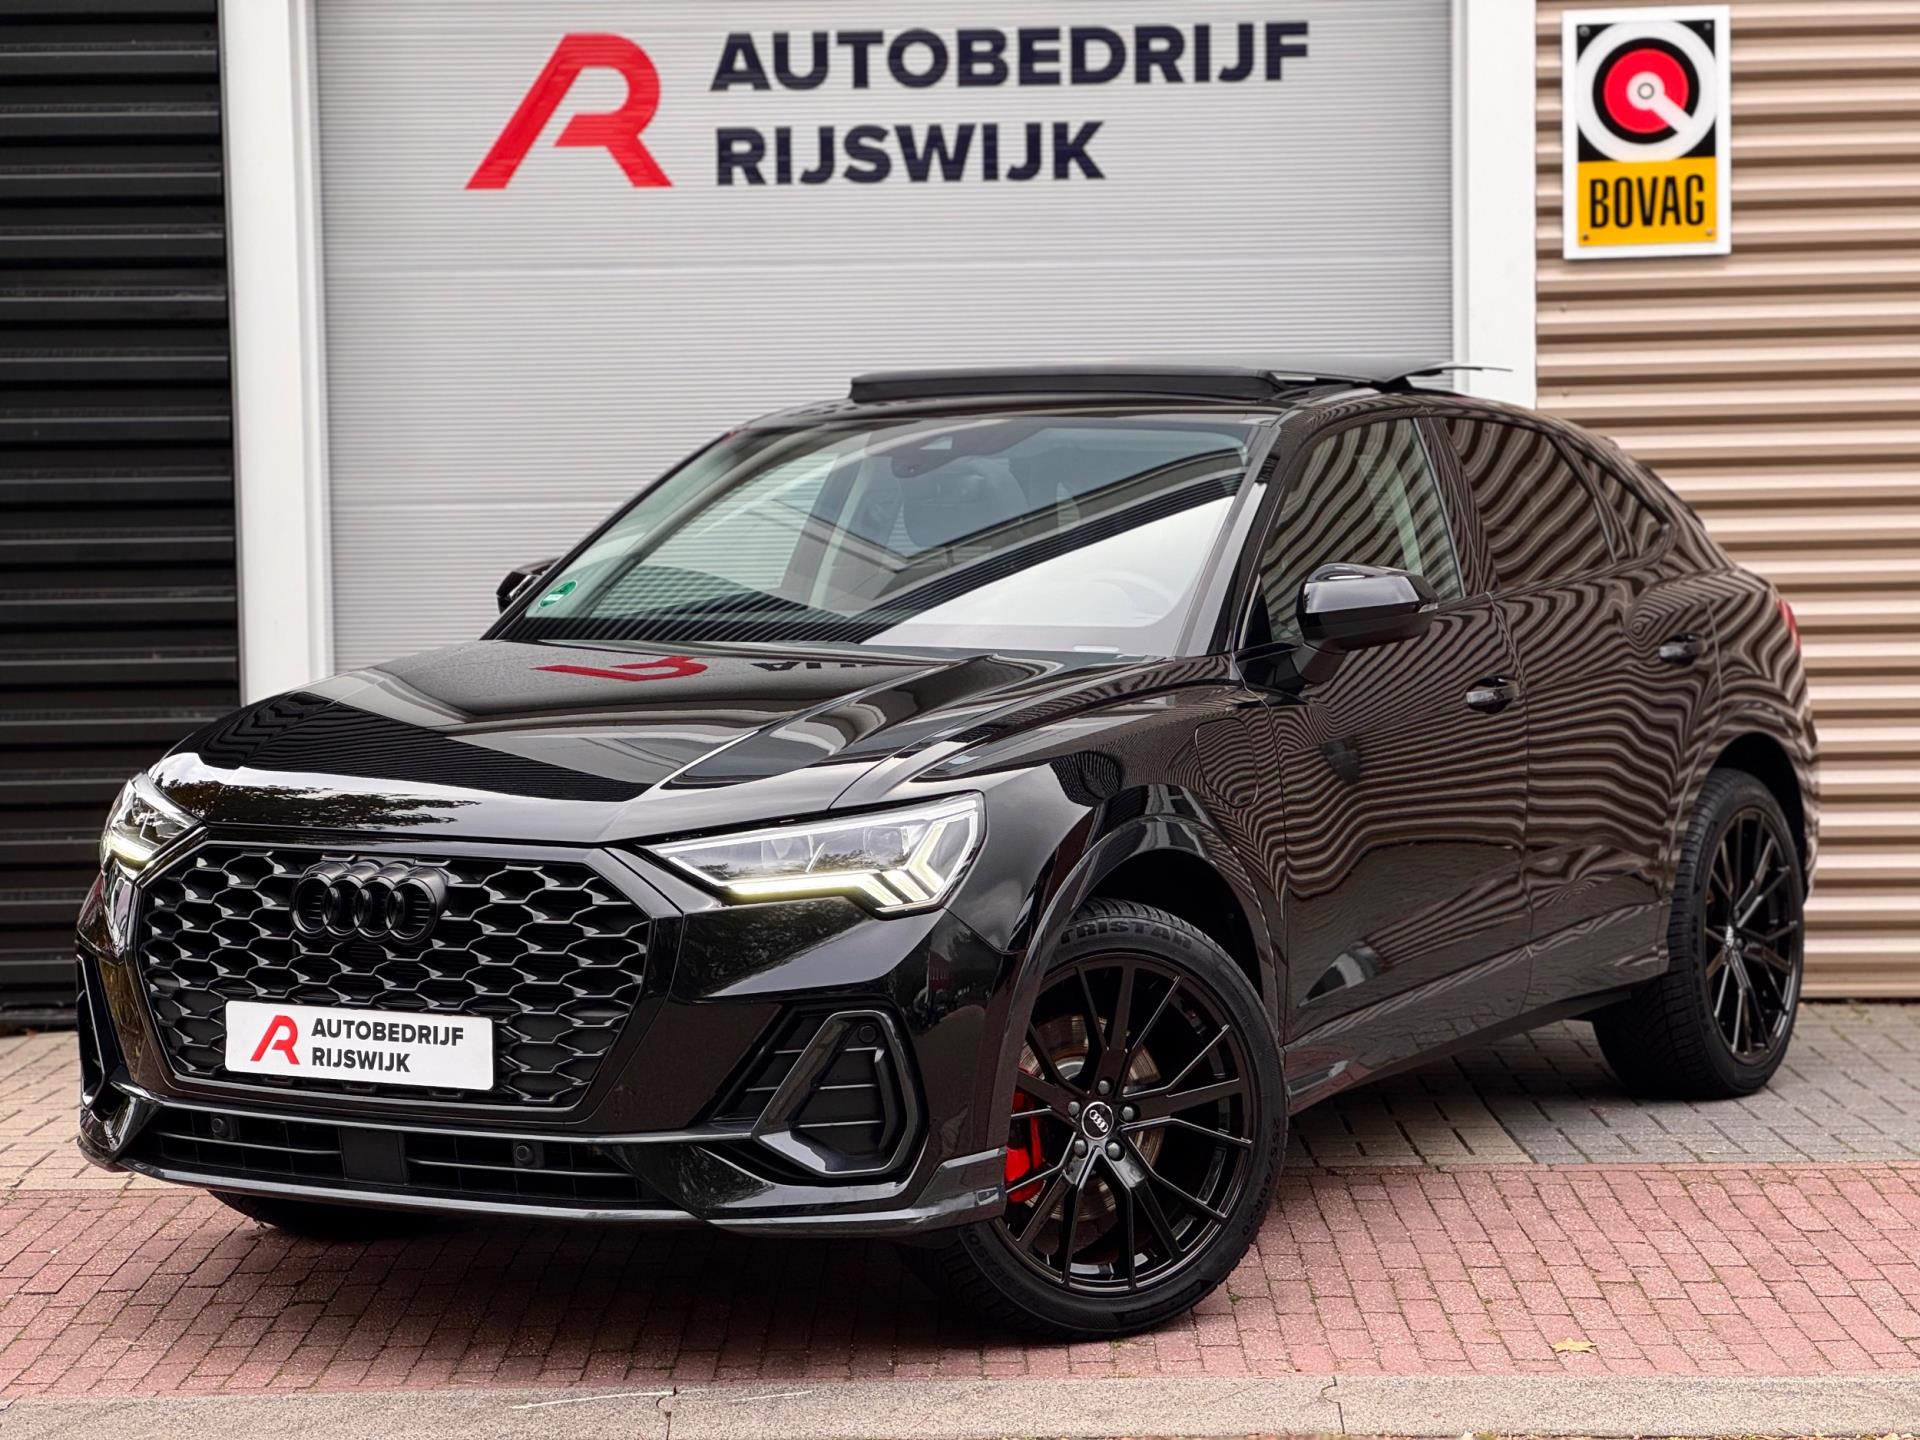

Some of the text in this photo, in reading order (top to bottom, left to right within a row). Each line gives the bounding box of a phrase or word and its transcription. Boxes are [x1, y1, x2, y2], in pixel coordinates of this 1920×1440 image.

[710, 21, 1309, 92] AUTOBEDRIJF
[716, 121, 1105, 187] RIJSWIJK
[1589, 174, 1705, 229] BOVAG
[311, 1017, 464, 1046] AUTOBEDRIJF
[311, 1046, 411, 1073] RIJSWIJK
